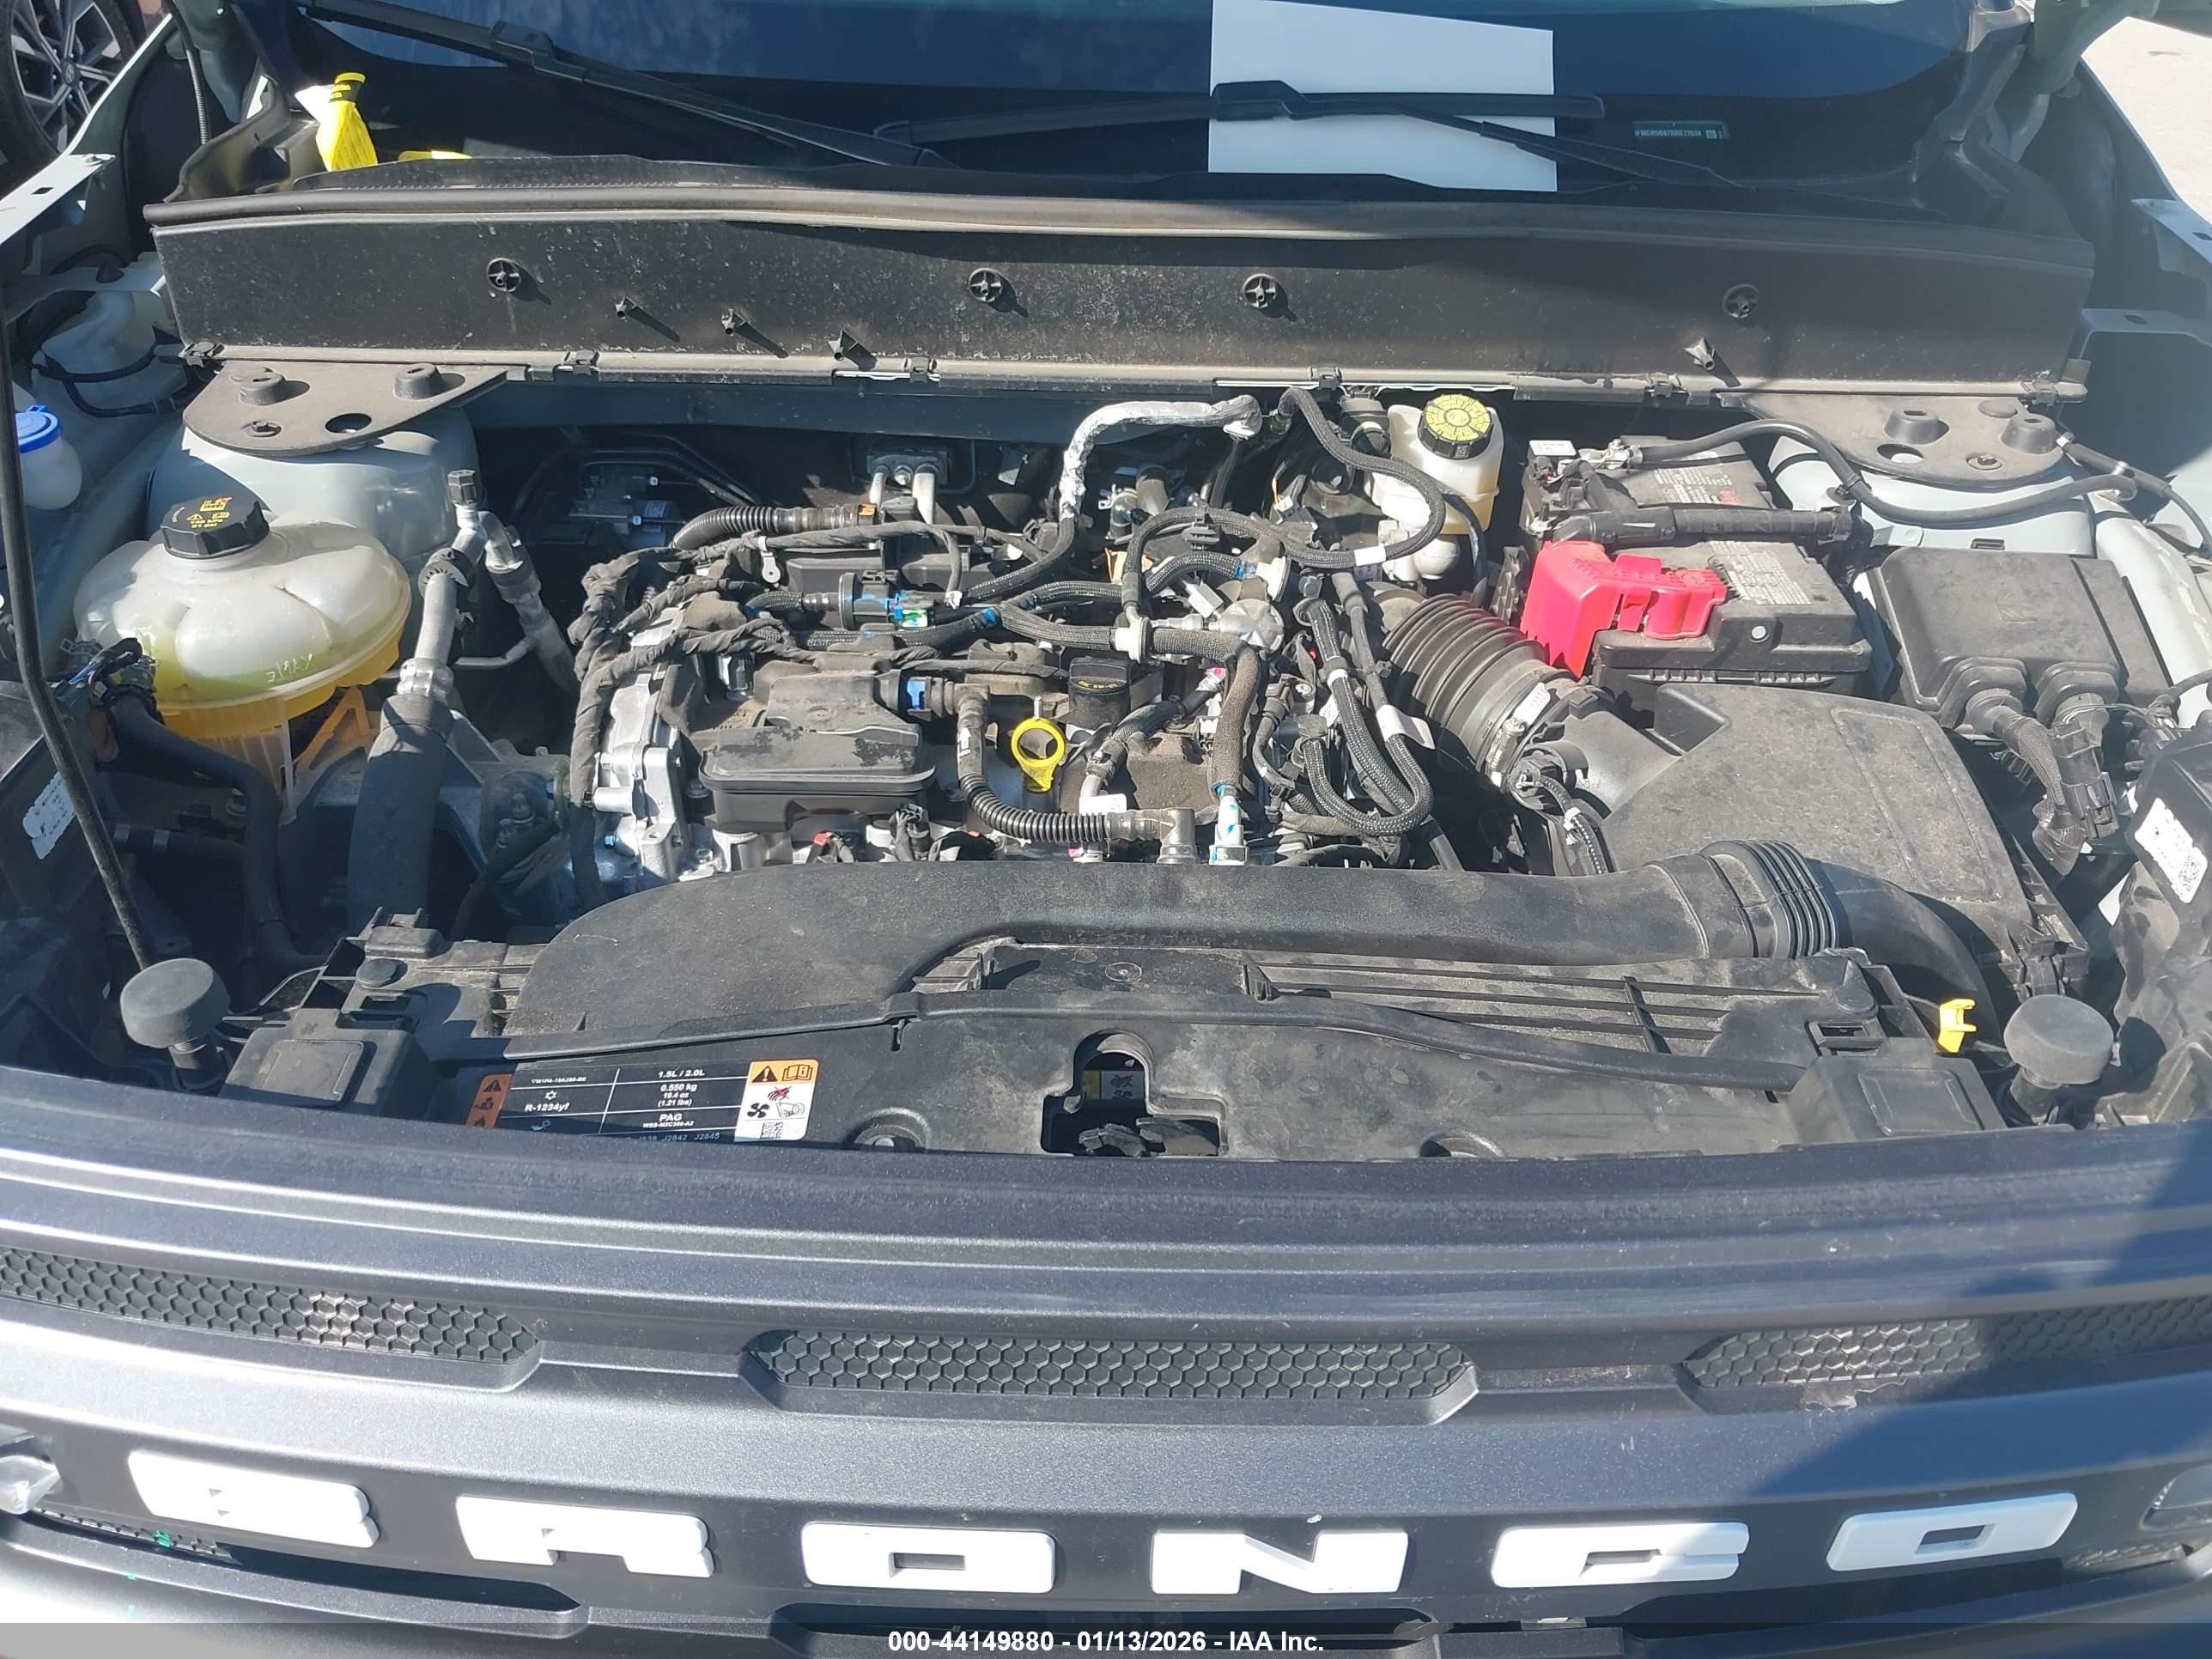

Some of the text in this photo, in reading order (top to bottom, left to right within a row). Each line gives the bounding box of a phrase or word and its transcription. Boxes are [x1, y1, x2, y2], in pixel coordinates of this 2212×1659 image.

[658, 1070, 678, 1079] 1.5L
[660, 1083, 698, 1092] 0.550 kg
[524, 1103, 570, 1113] R-1234yf
[659, 1113, 683, 1121] PAG
[693, 1132, 721, 1140] J2845
[128, 1450, 2079, 1595] BRONCO
